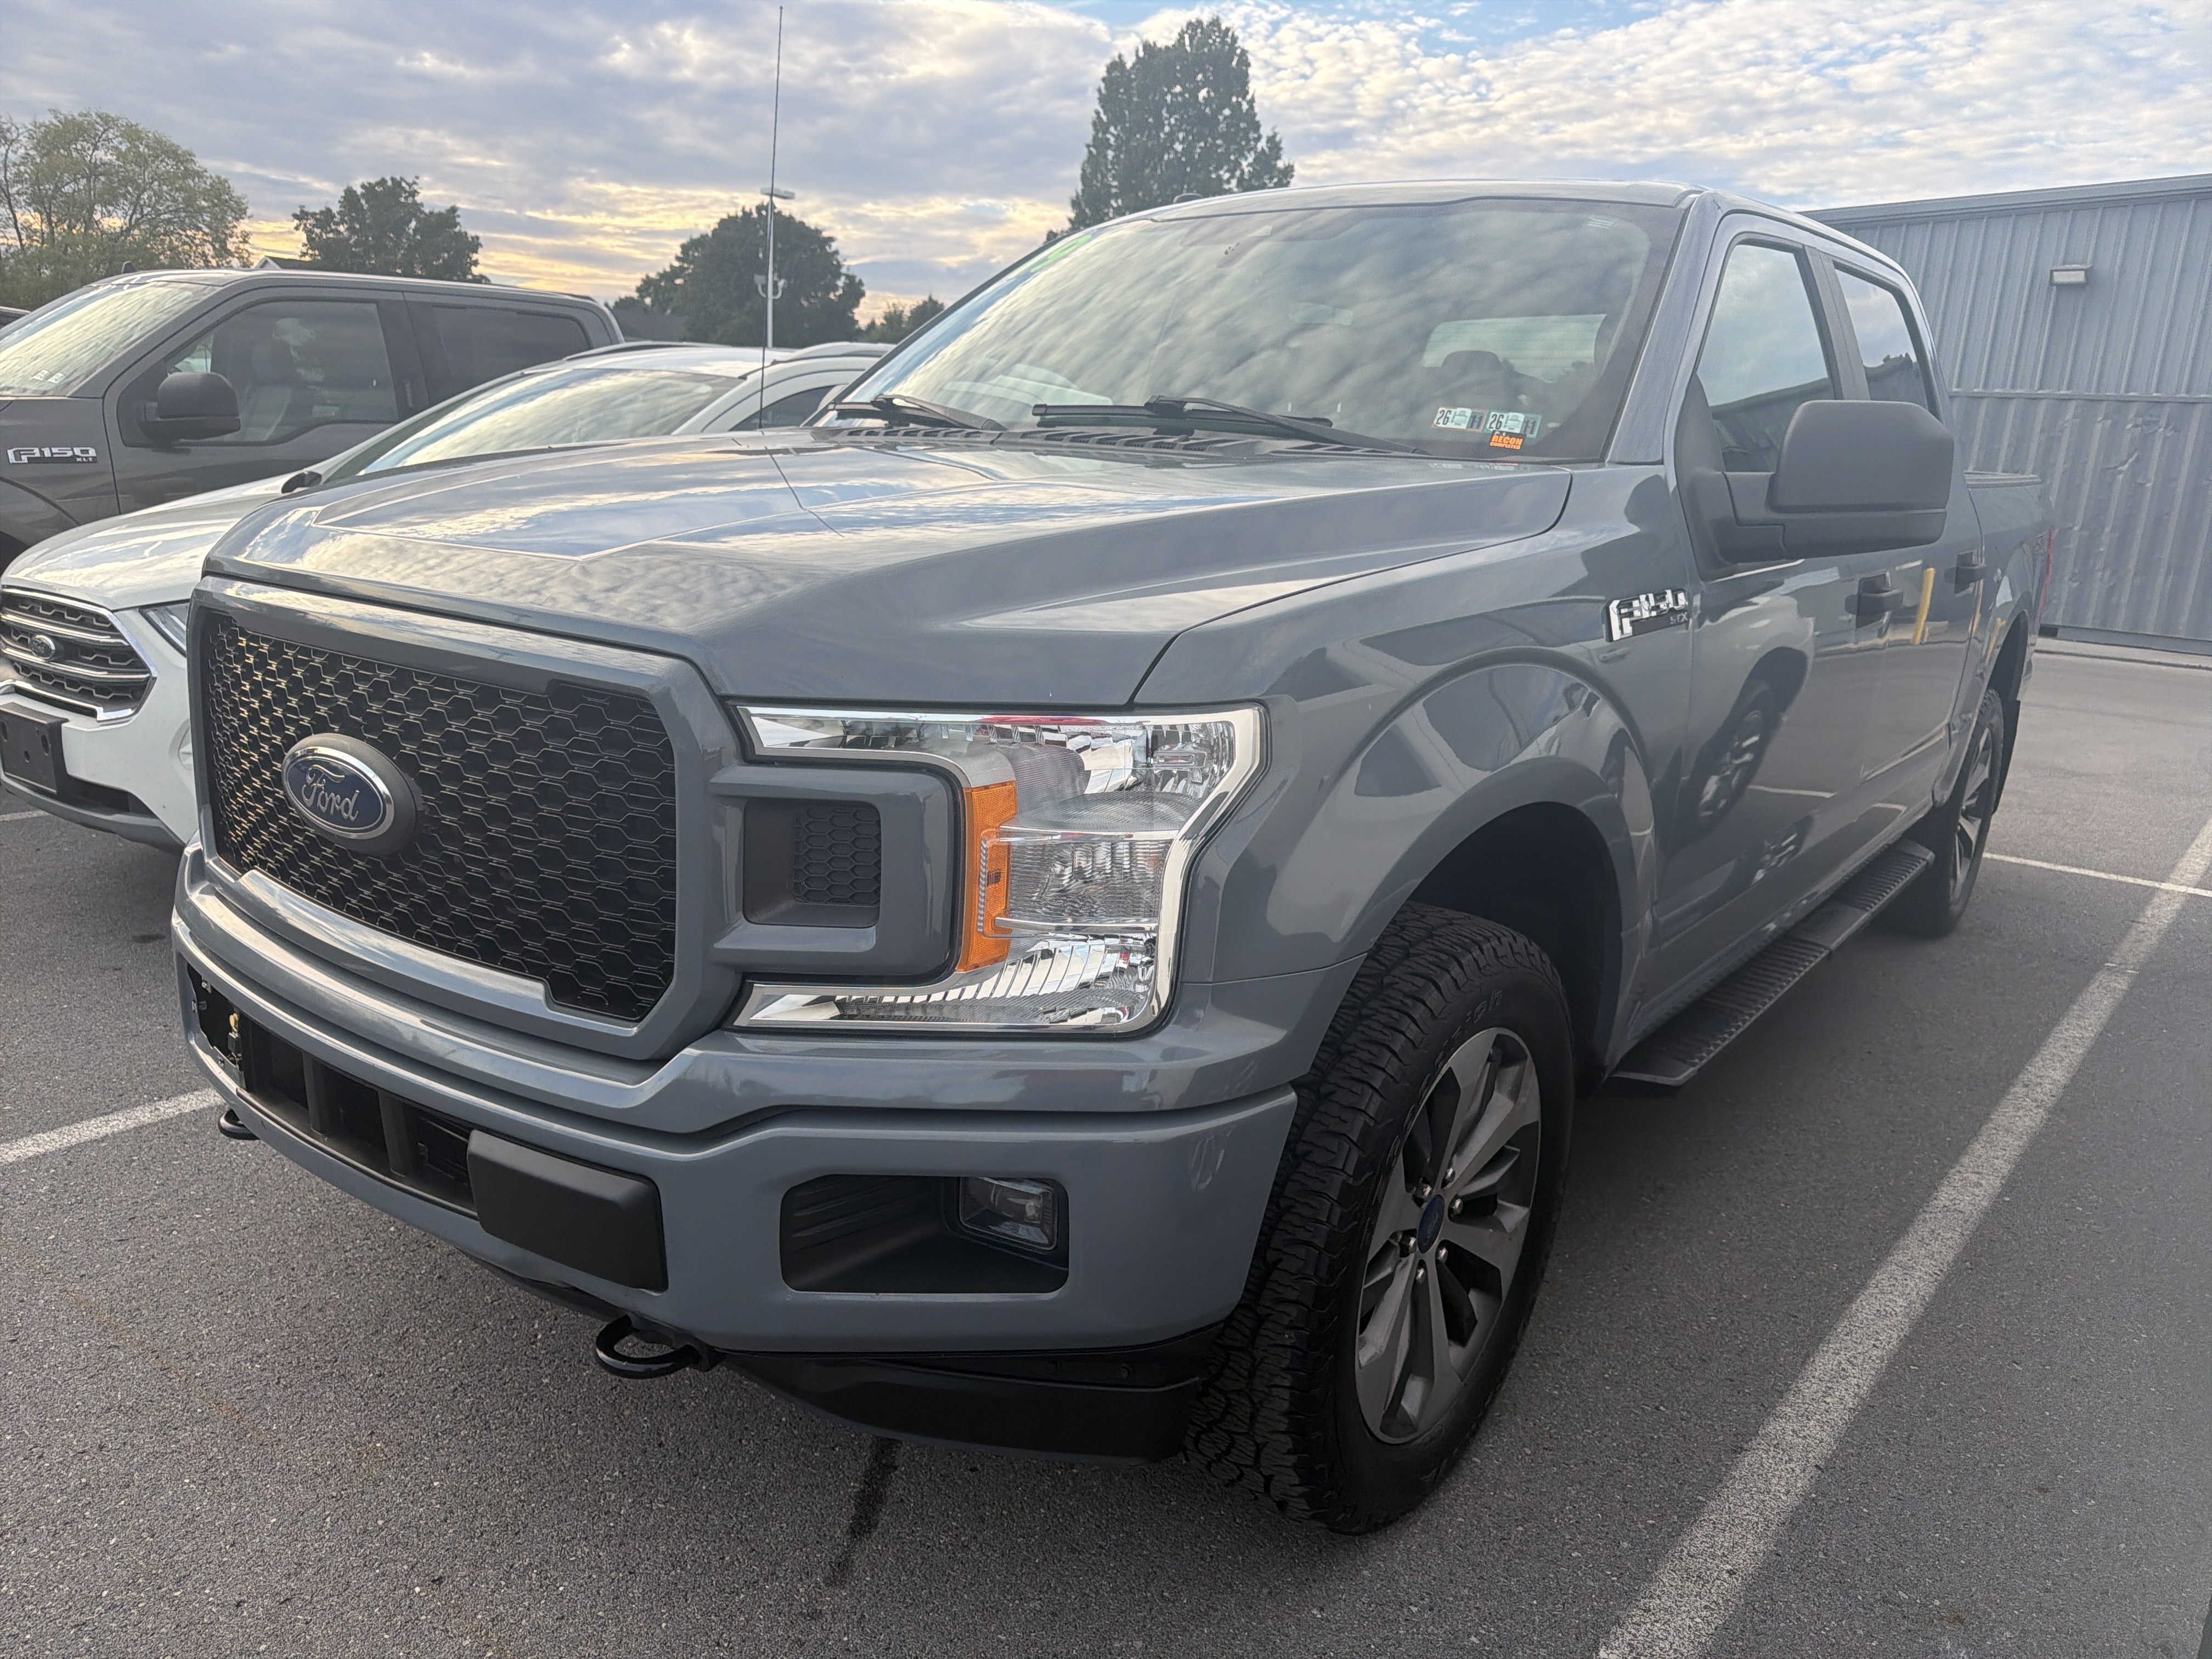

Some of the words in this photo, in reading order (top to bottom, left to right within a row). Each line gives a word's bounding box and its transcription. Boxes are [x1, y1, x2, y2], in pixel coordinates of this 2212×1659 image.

[1436, 410, 1452, 426] 26
[1488, 414, 1504, 430] 26
[1492, 435, 1523, 445] RECON
[302, 764, 360, 821] Ford
